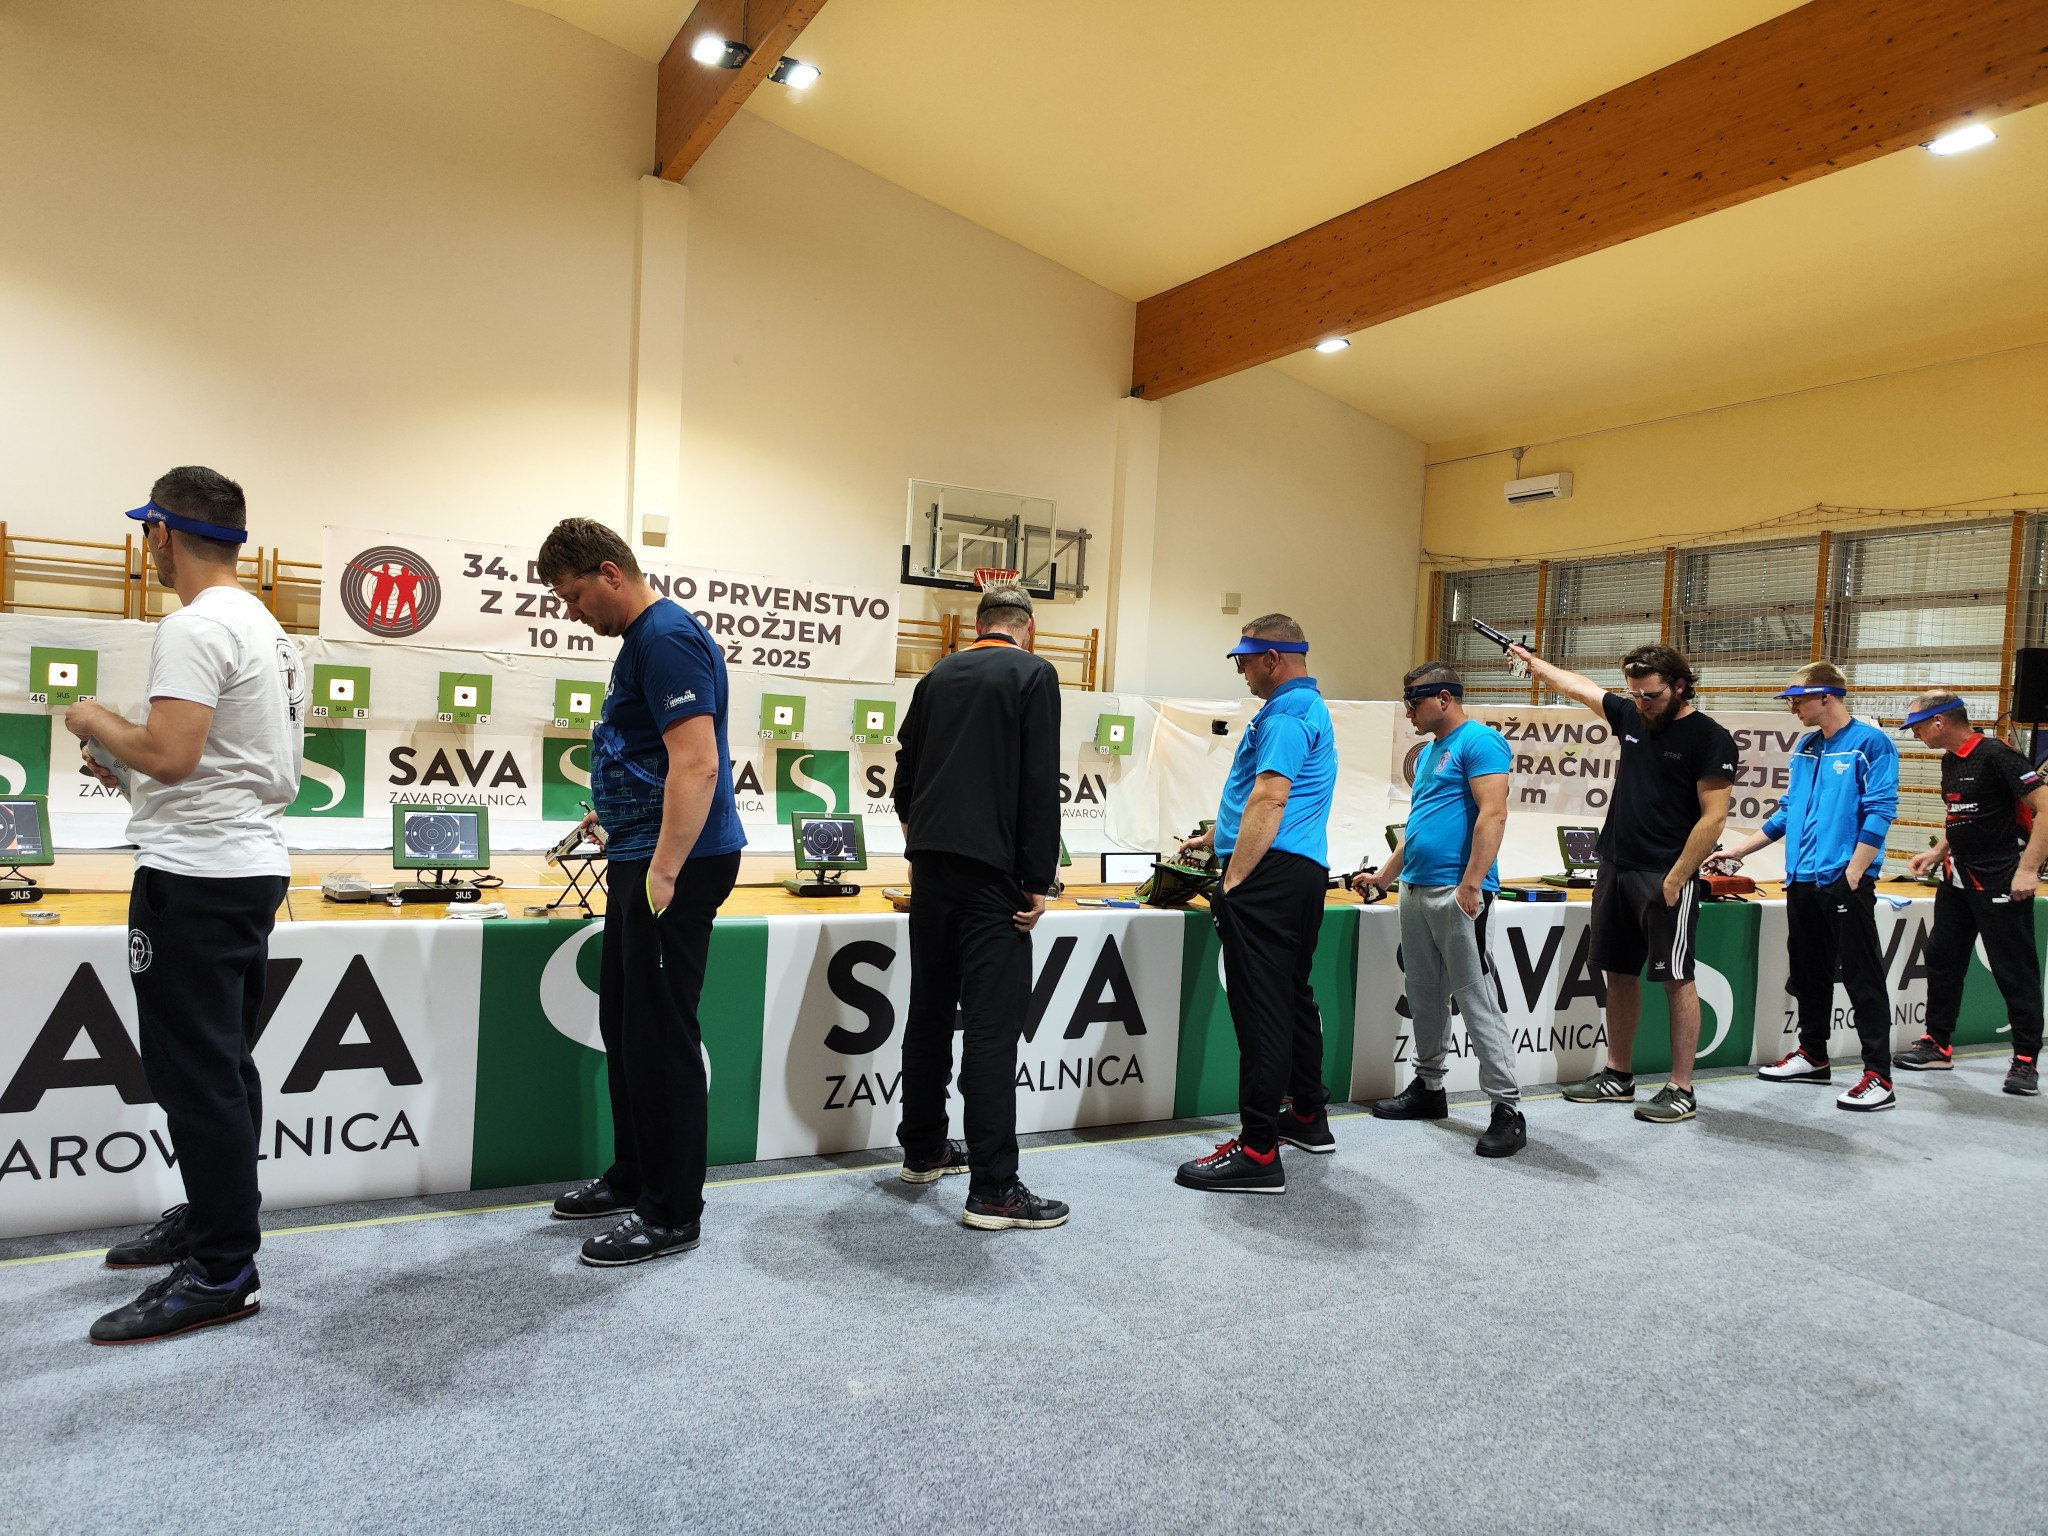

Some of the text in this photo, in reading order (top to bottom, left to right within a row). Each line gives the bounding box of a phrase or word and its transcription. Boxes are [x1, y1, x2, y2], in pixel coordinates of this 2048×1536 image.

[462, 553, 518, 582] 34.
[708, 580, 890, 620] PRVENSTVO
[480, 589, 503, 615] Z
[528, 627, 558, 649] 10
[567, 636, 594, 651] m
[752, 647, 811, 670] 2025
[31, 694, 46, 703] 46
[313, 707, 365, 718] 48 B
[439, 714, 487, 724] 49 C
[556, 719, 568, 727] 50
[762, 730, 800, 740] 52 F
[855, 735, 892, 744] 53 G
[388, 746, 527, 789] SAVA
[1508, 751, 1620, 780] RAČNI
[389, 791, 527, 806] ZAVAROVALNICA
[10, 890, 31, 900] SIUS
[455, 891, 472, 899] SIUS
[841, 886, 854, 894] SIUS
